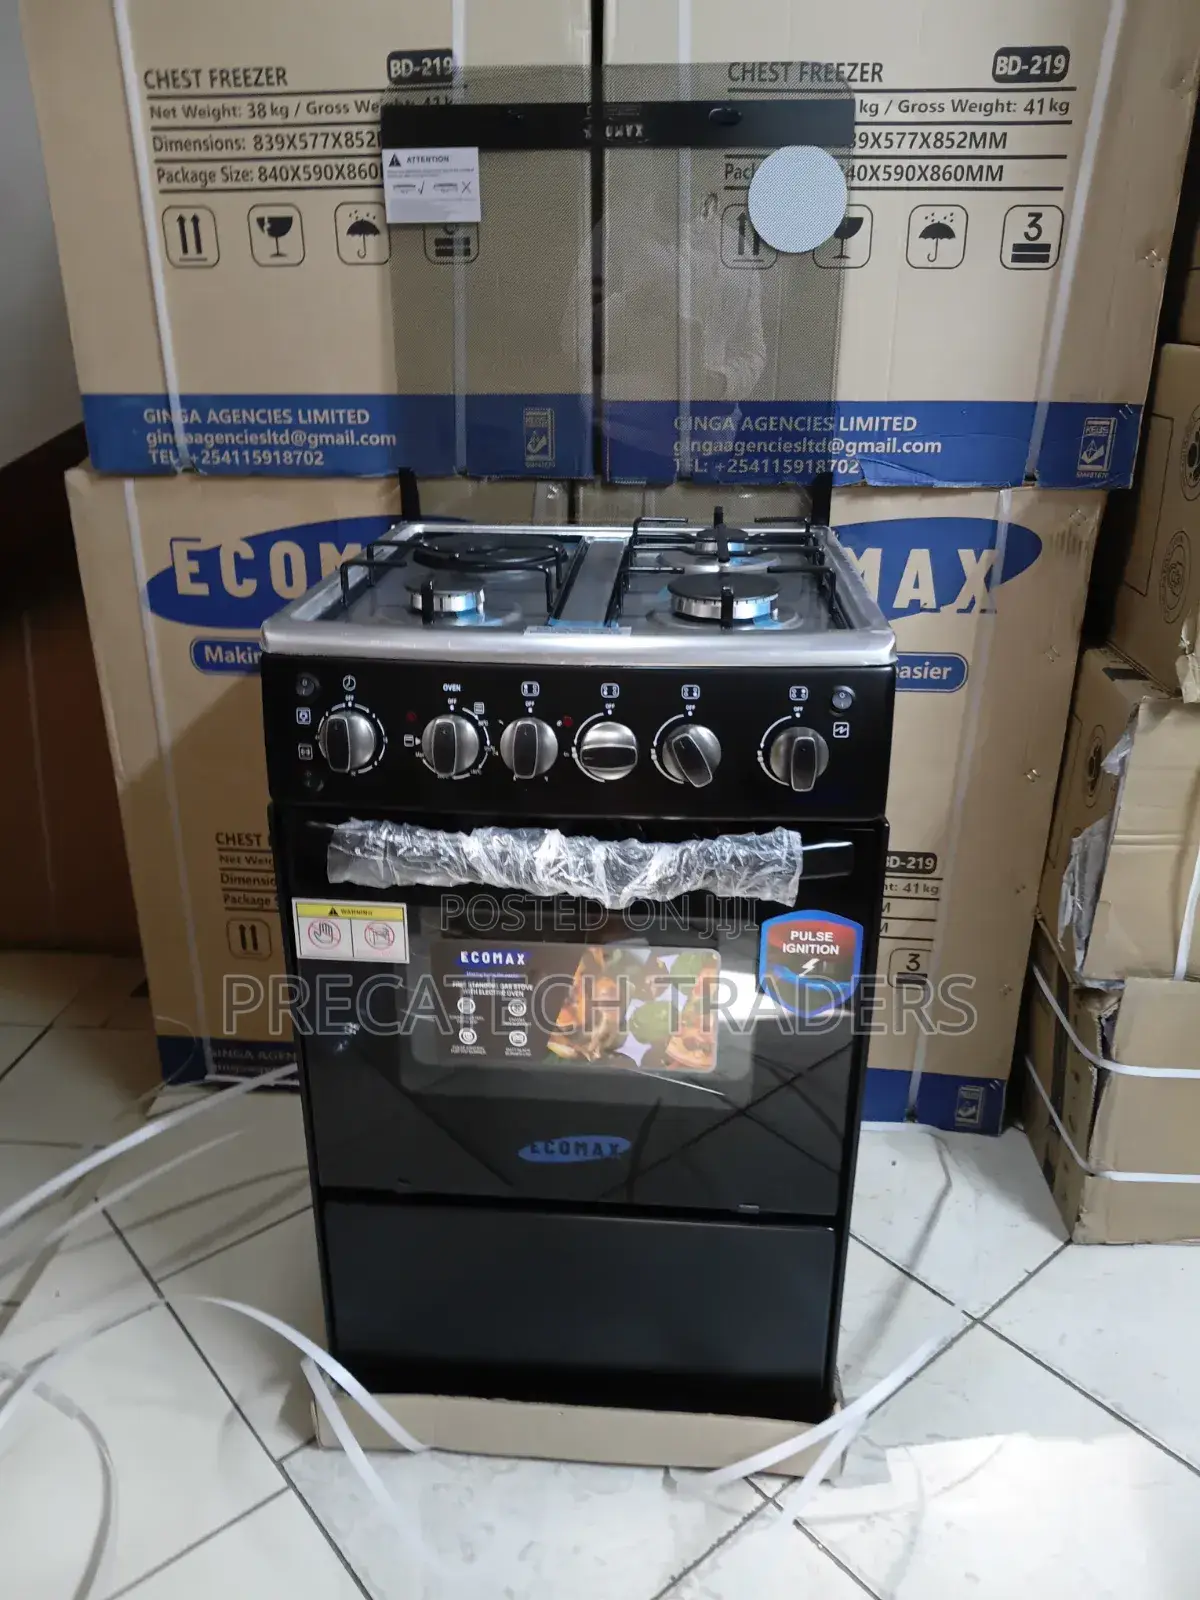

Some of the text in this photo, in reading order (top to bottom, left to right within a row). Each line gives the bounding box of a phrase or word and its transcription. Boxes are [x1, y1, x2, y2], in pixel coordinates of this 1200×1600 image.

[727, 61, 883, 83] CHEST FREEZER
[994, 54, 1067, 76] BD-219
[143, 66, 288, 90] CHEST FREEZER
[150, 105, 177, 119] Net
[182, 103, 242, 121] Weight:
[247, 103, 267, 118] 38
[271, 102, 289, 119] kg
[306, 101, 350, 116] Gross
[859, 99, 879, 117] kg
[897, 98, 946, 114] Gross
[951, 98, 1017, 116] Weight:
[1023, 98, 1045, 115] 41
[1049, 98, 1071, 116] kg
[152, 131, 381, 152] Dimensions: 839X577X852
[852, 131, 1008, 150] 9X577X852MM
[157, 167, 217, 189] Package
[222, 166, 253, 183] Size:
[258, 162, 379, 182] 840X590X860
[845, 163, 1004, 182] 40X590X860MM
[1024, 212, 1044, 242] 3
[206, 408, 293, 425] AGENCIES
[298, 409, 370, 425] LIMITED
[673, 415, 917, 432] GINGA AGENCIES LIMITED
[146, 429, 397, 448] ginaagenciesltd@gmail.com
[714, 457, 860, 475] +254115918702
[842, 547, 997, 609] MAX
[204, 645, 262, 664] Makin
[443, 683, 461, 692] OVEN
[215, 832, 262, 847] CHEST
[902, 882, 919, 894] 41
[923, 884, 940, 896] kg
[790, 930, 834, 943] PULSE
[461, 950, 525, 966] ECOMAX
[782, 943, 840, 956] IGNITION
[906, 953, 921, 972] 3
